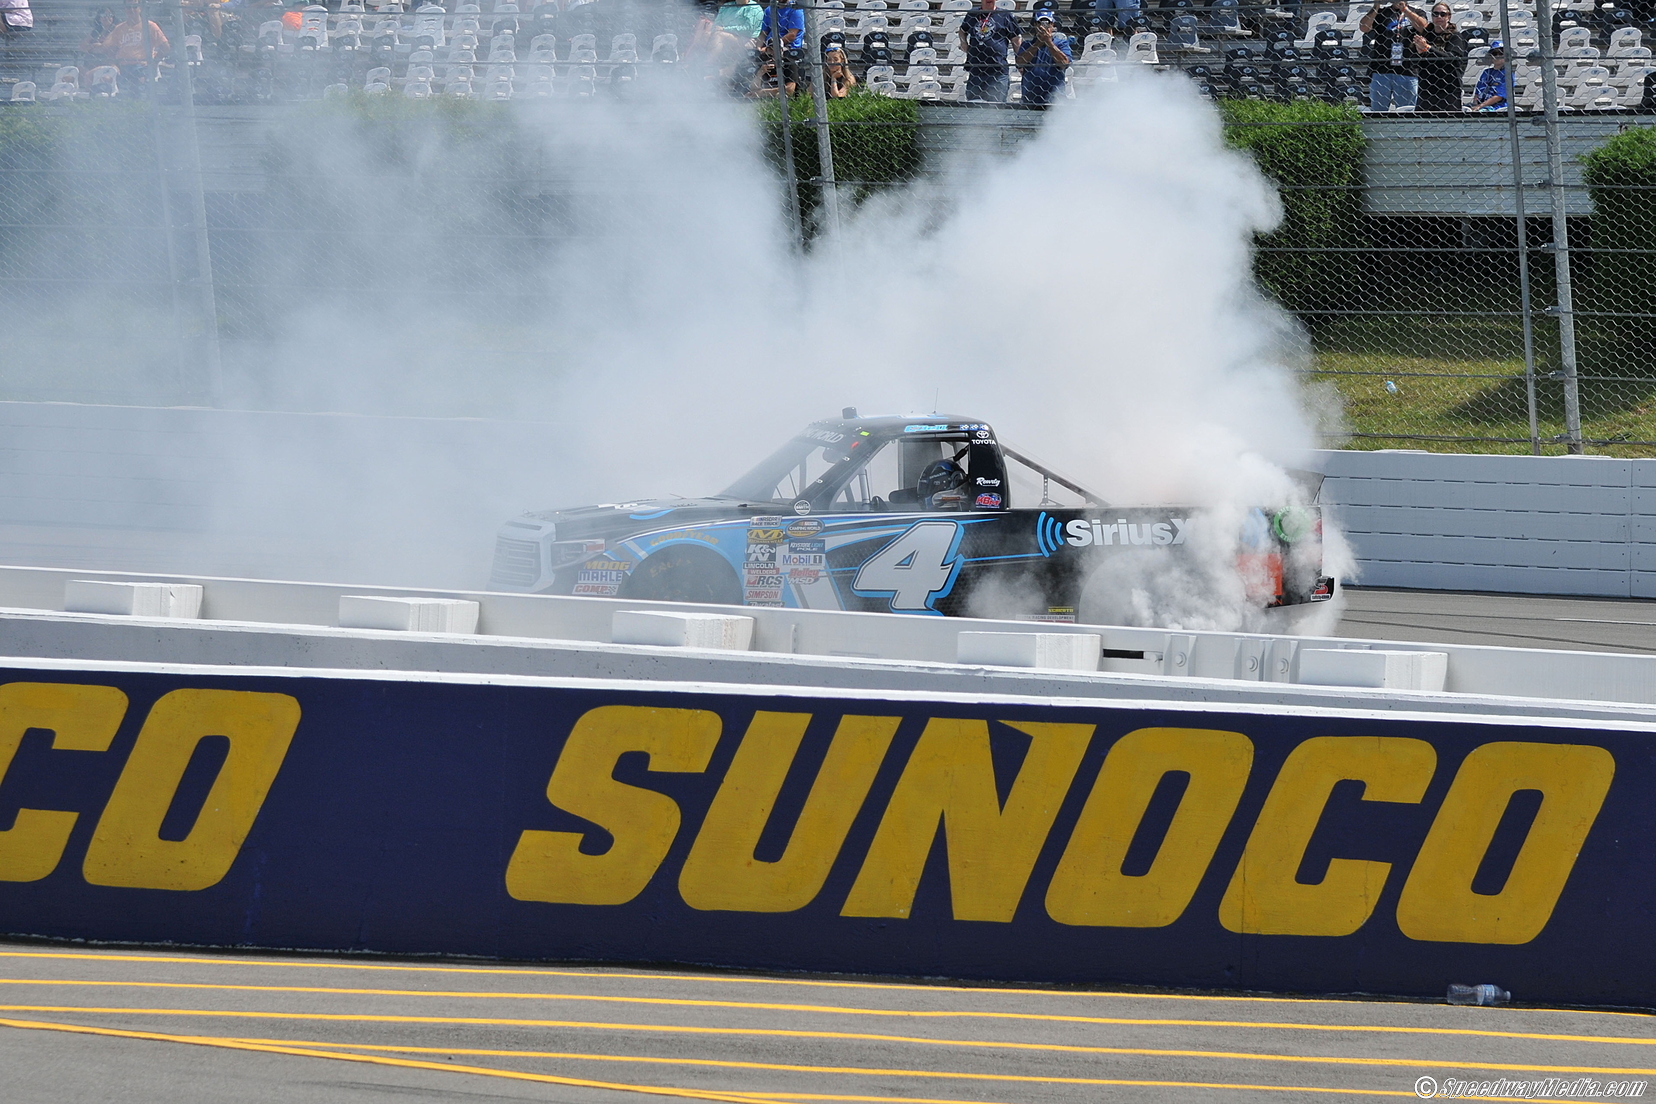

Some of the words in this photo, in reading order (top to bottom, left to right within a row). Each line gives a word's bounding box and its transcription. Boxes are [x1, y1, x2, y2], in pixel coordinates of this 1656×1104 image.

[782, 554, 811, 563] Mobil
[584, 561, 632, 571] MOOG
[851, 520, 962, 613] 4
[578, 571, 623, 582] MAHLE
[789, 568, 819, 578] Holley
[756, 575, 783, 585] RCS
[574, 585, 608, 594] COMP
[747, 590, 779, 599] SIMPSON
[505, 704, 1616, 946] SUNOCO
